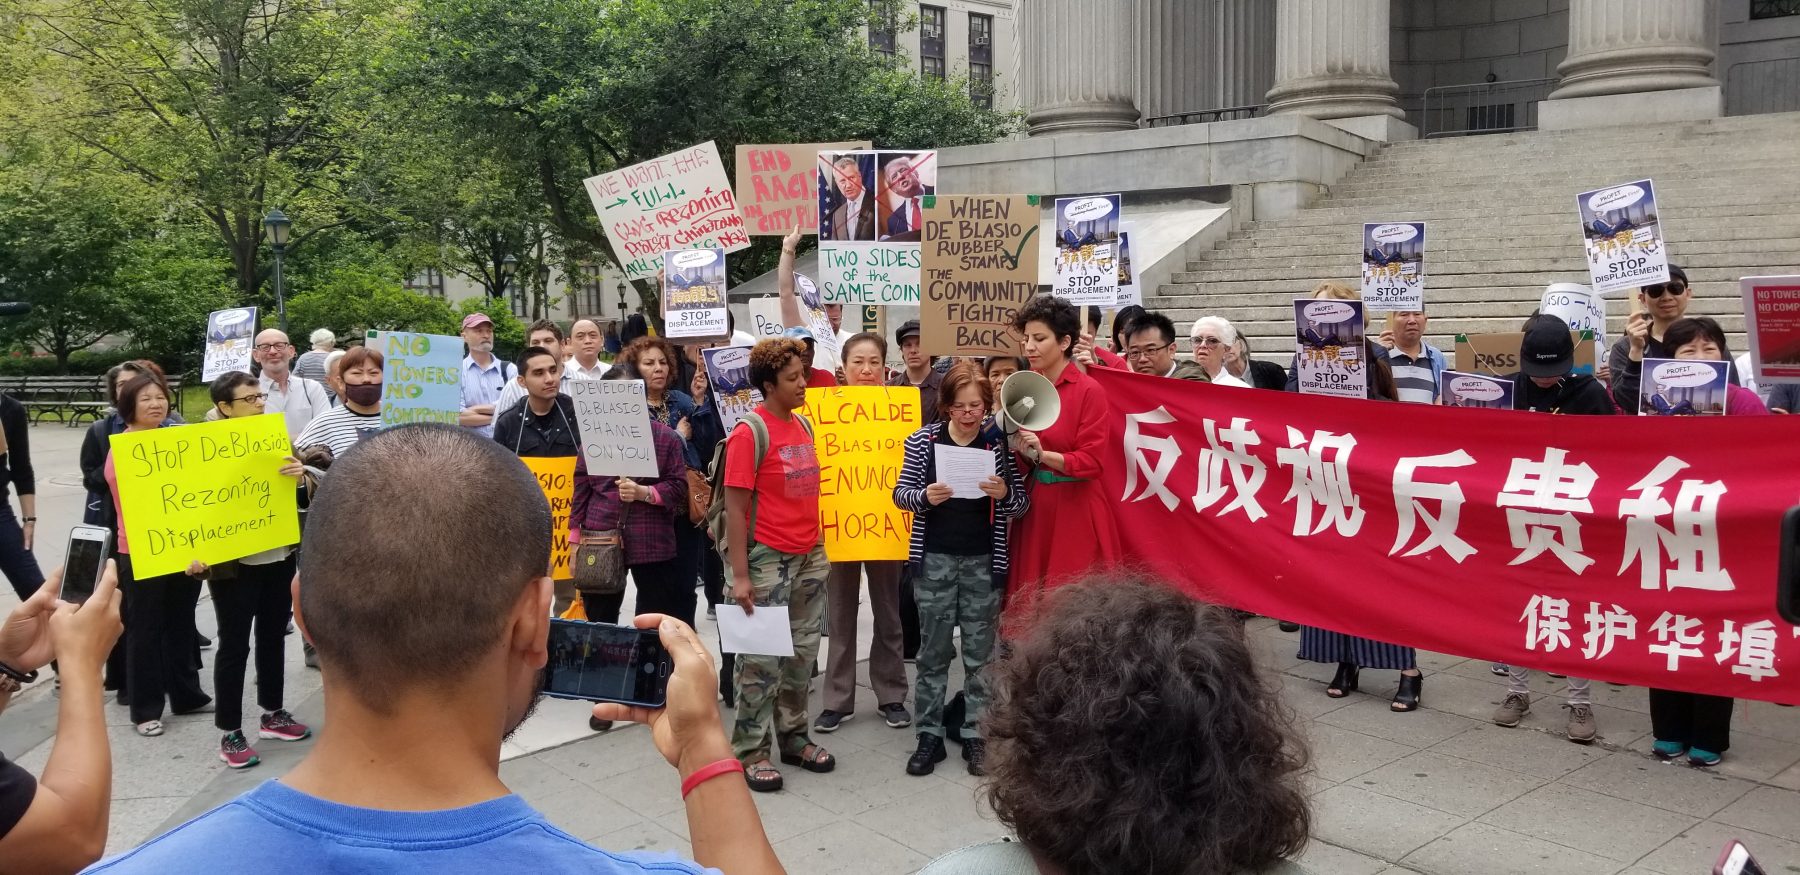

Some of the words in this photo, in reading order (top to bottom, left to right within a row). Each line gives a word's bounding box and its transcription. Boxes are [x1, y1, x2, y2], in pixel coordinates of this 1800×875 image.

[747, 149, 792, 173] END
[591, 175, 620, 198] WE
[630, 182, 686, 208] FULL
[1599, 190, 1621, 203] PROFIT
[743, 204, 764, 219] IN
[950, 196, 1011, 220] WHEN
[757, 208, 792, 233] CITY
[796, 205, 818, 229] PL
[926, 220, 954, 242] DE
[958, 220, 1022, 240] BLASIO
[937, 239, 1005, 257] RUBBER
[822, 248, 858, 269] TWO
[866, 248, 921, 269] SIDES
[1608, 257, 1647, 273] STOP
[843, 270, 859, 282] of
[866, 270, 891, 283] the
[927, 269, 953, 280] THE
[1068, 275, 1101, 287] STOP
[1595, 264, 1665, 284] DISPLACEMENT
[824, 282, 878, 304] SAME
[881, 282, 920, 303] COIN
[928, 279, 1038, 304] COMMUNITY
[1055, 285, 1115, 296] DISPLACEMENT
[1363, 295, 1420, 303] DISPLACEMENT
[1376, 287, 1407, 297] STOP
[1757, 290, 1770, 299] NO
[680, 310, 712, 321] STOP
[947, 302, 1018, 325] FIGHTS
[1314, 305, 1335, 313] PROFIT
[1758, 303, 1771, 312] NO
[668, 318, 725, 328] DISPLACEMENT
[755, 314, 784, 337] PEO
[388, 335, 431, 357] NO
[956, 326, 1011, 349] BACK
[214, 358, 239, 368] STOP
[1474, 353, 1518, 369] PASS
[1666, 365, 1692, 375] PROFIT
[387, 358, 460, 386] TOWERS
[1314, 372, 1349, 384] STOP
[385, 382, 424, 400] NO
[575, 382, 644, 395] DEVELOPER
[1301, 380, 1364, 392] DISPLACEMENT
[800, 401, 914, 426] ALCALDE
[582, 418, 642, 439] SHAME
[587, 443, 613, 459] ON
[617, 443, 650, 461] YOU!
[161, 474, 272, 515] Rezoning
[1121, 405, 1736, 592] 反歧视反贵租
[147, 510, 277, 556] Displacement
[1518, 593, 1800, 683] 保护华埠
